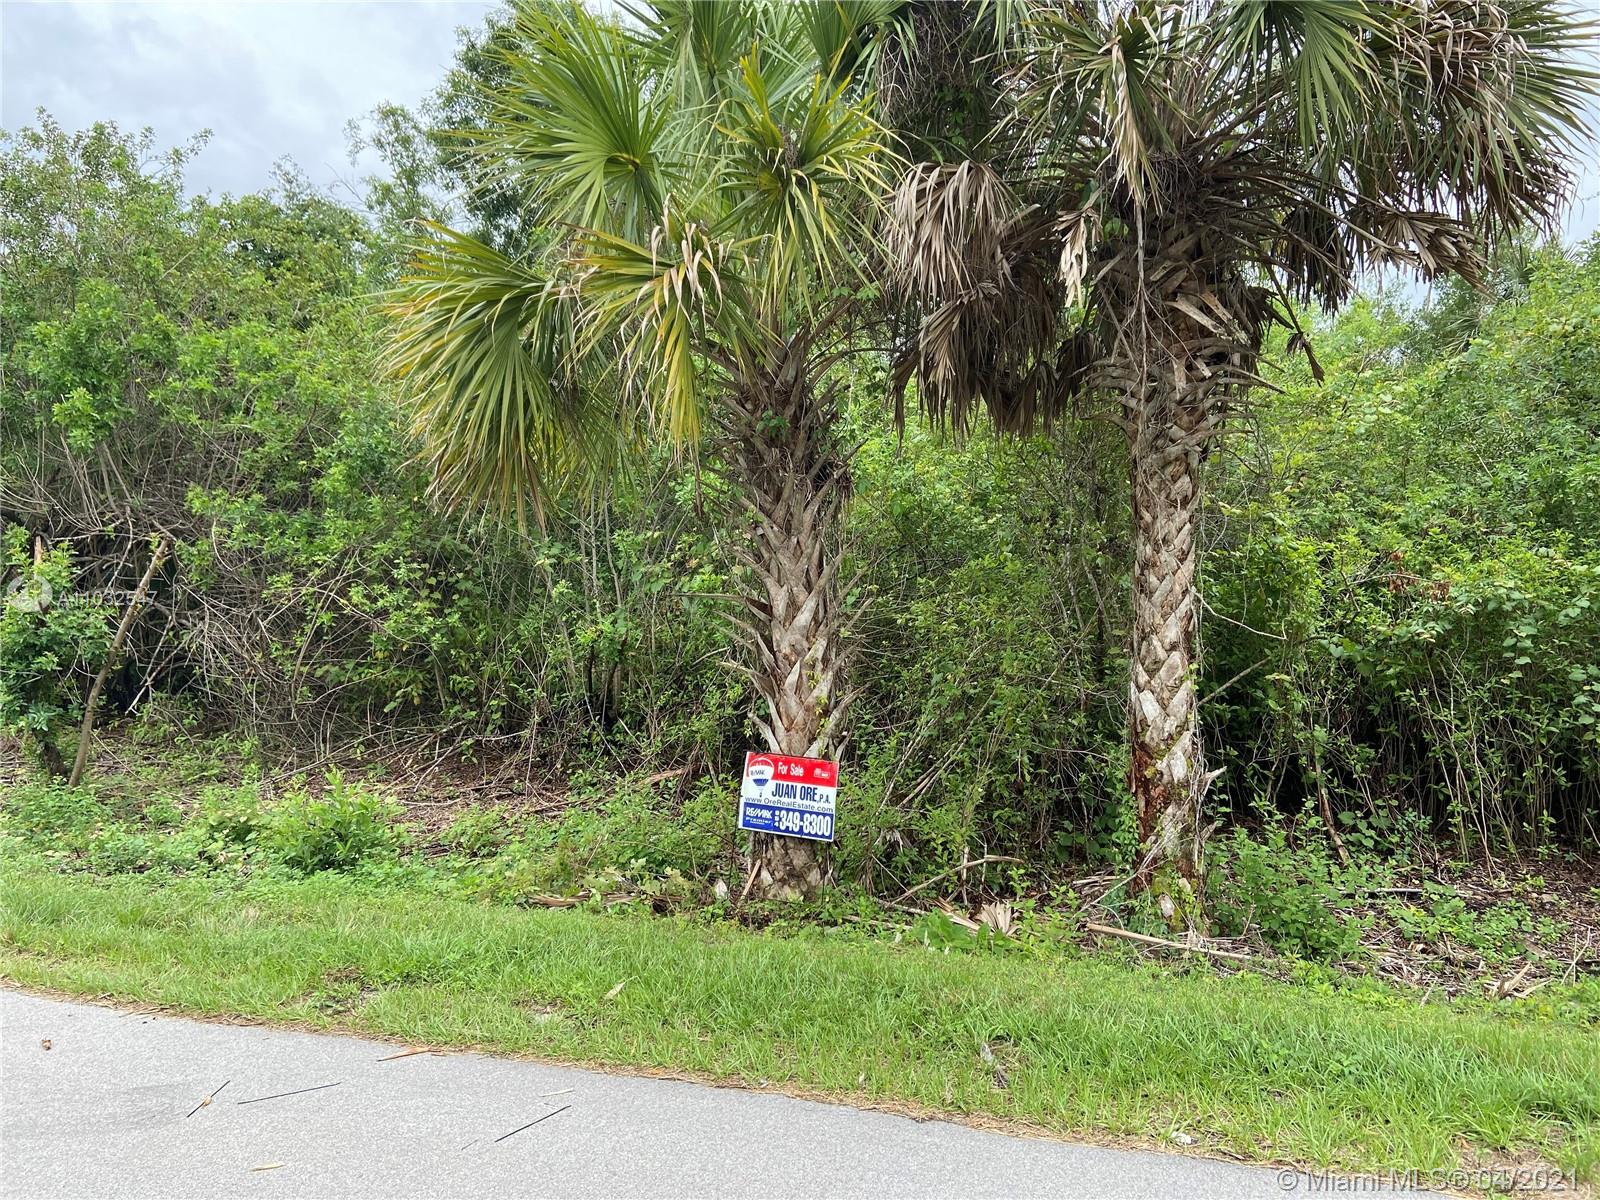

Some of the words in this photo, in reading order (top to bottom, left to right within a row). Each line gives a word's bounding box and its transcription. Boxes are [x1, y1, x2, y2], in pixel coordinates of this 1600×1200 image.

[778, 762, 788, 775] For
[790, 763, 804, 777] Sale
[772, 783, 798, 799] JUAN
[745, 797, 834, 813] www.OreRealEstate.com
[779, 809, 832, 837] 349-8300
